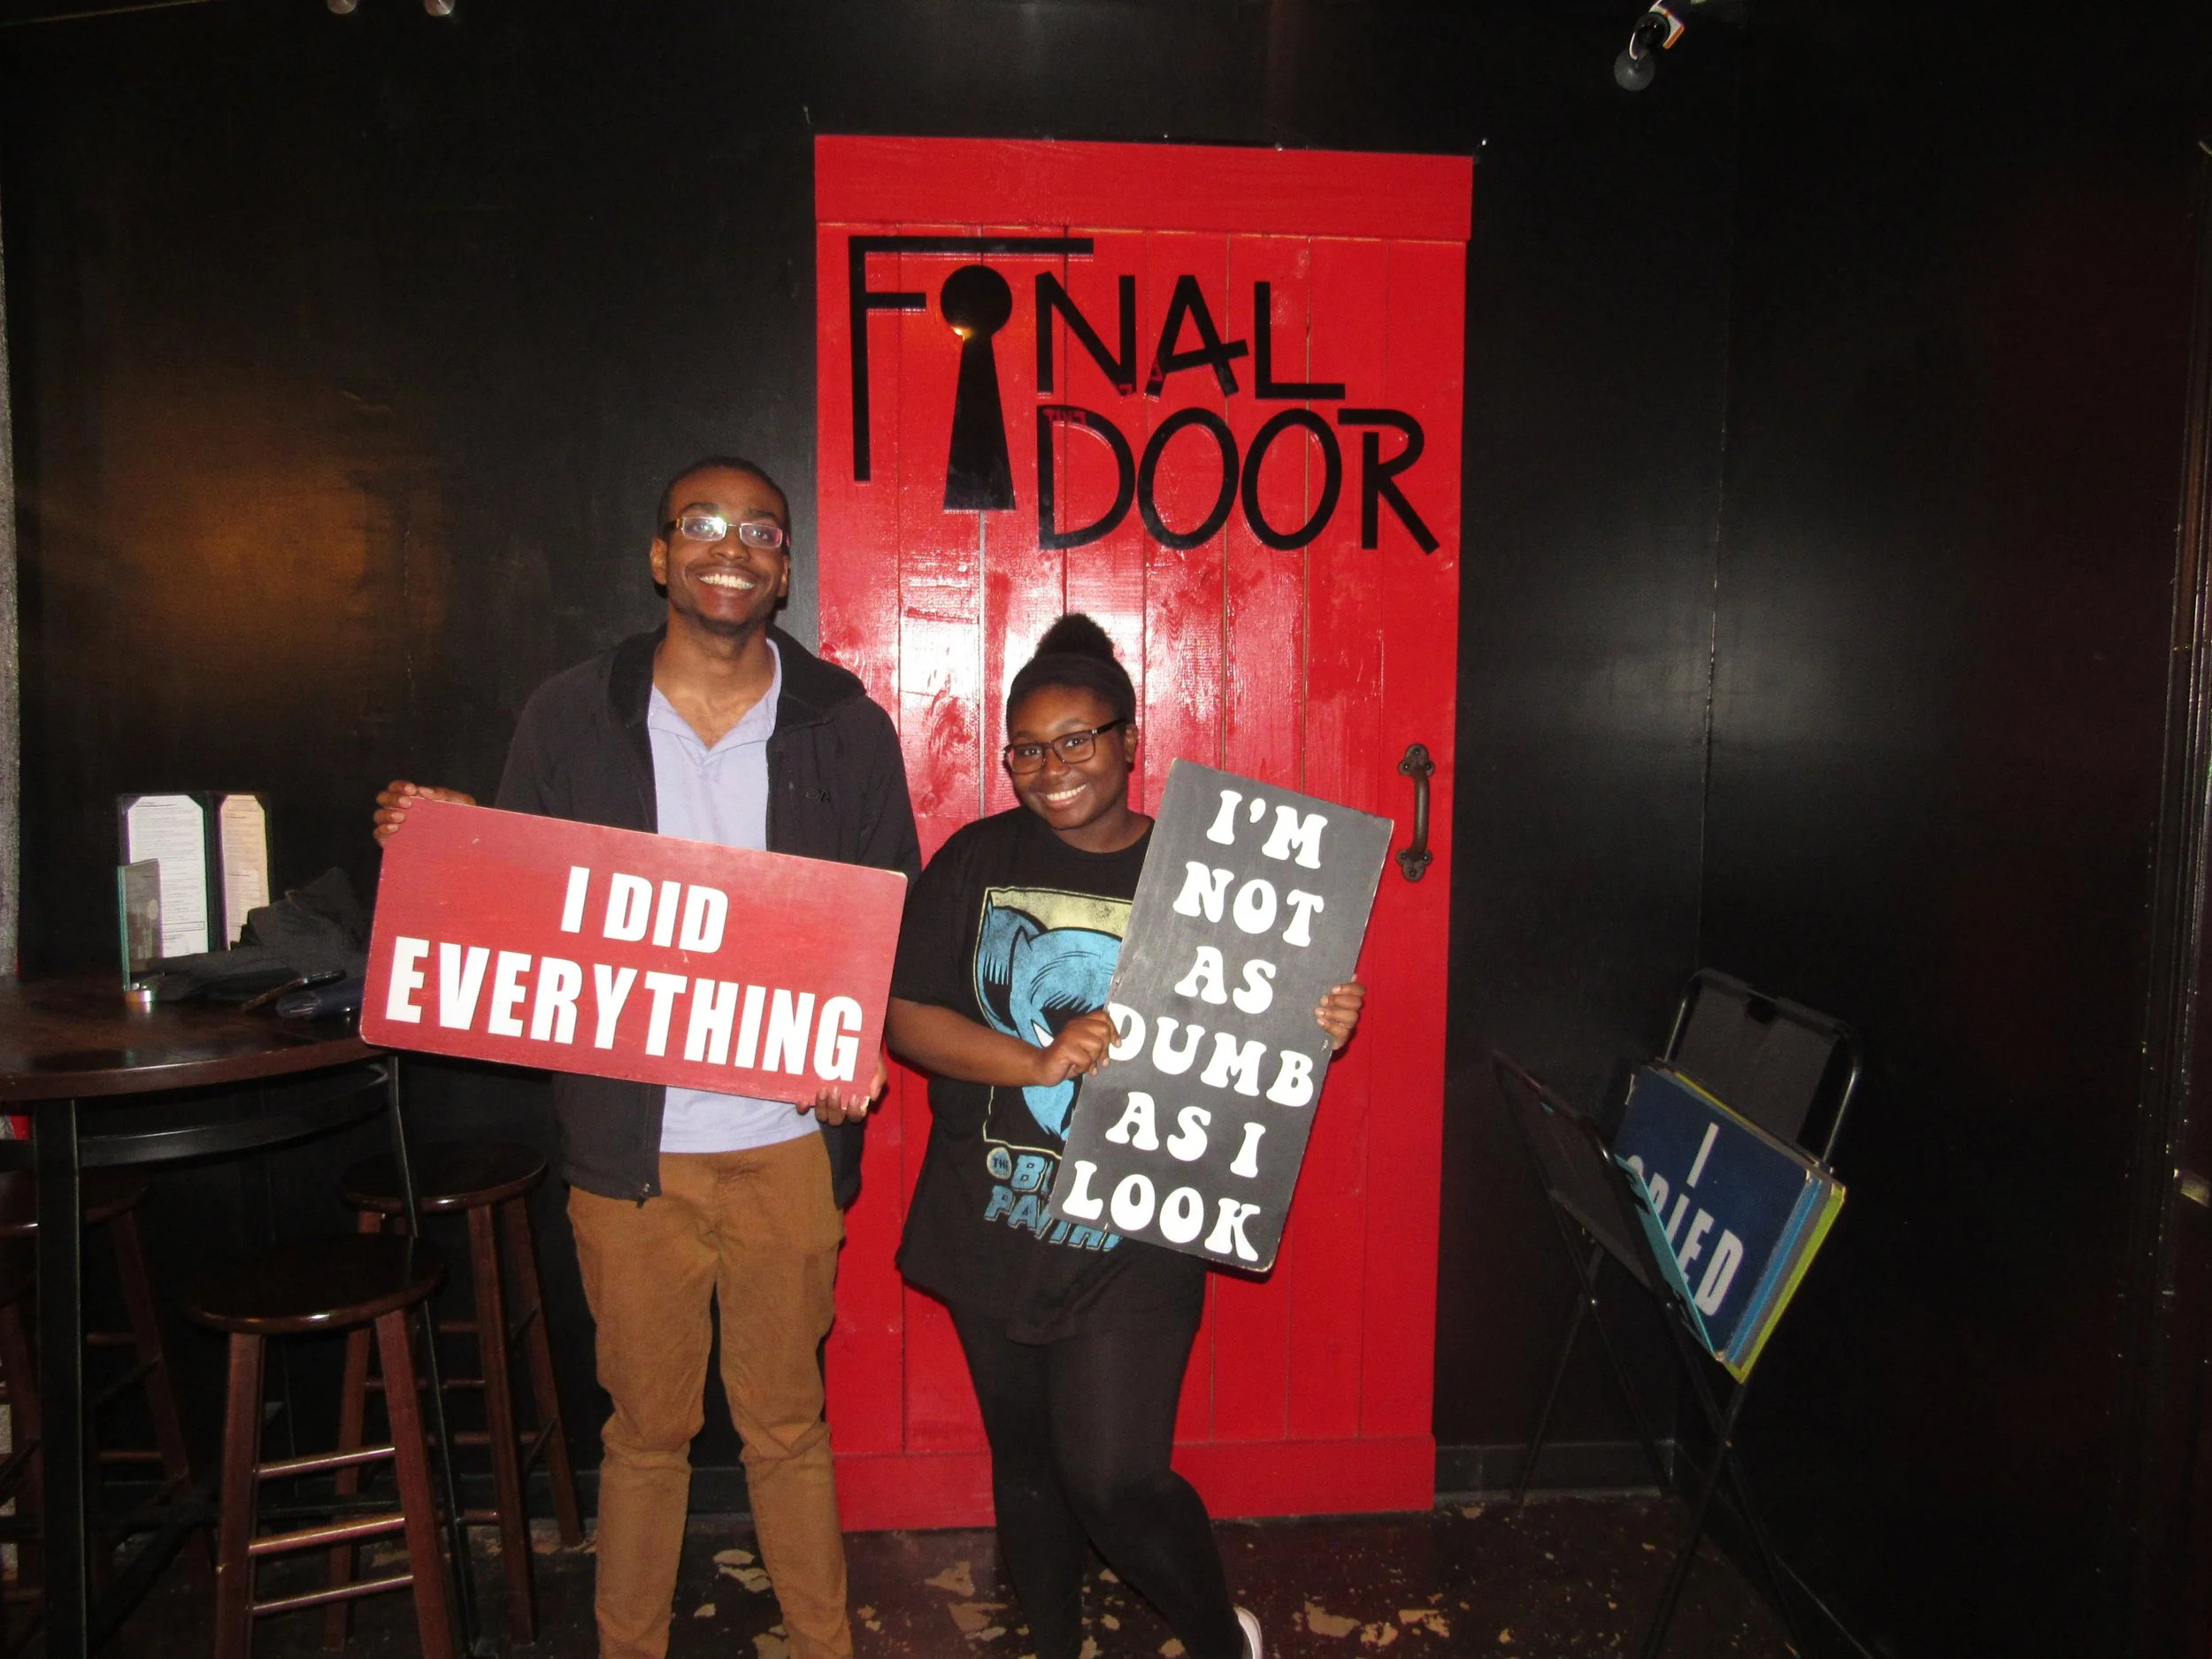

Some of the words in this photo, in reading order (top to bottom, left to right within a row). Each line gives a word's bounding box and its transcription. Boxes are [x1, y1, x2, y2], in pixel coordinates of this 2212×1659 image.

[849, 235, 1345, 511] FINAL
[1037, 404, 1440, 555] DOOR
[1207, 790, 1328, 869] I'M
[561, 866, 590, 933] I
[603, 872, 728, 954] DID
[1172, 861, 1324, 947] NOT
[385, 936, 863, 1082] EVERYTHING
[1174, 946, 1277, 1014] AS
[1108, 1002, 1314, 1107] DUMB
[1105, 1091, 1211, 1162] AS
[1230, 1122, 1266, 1179] I
[1686, 1122, 1719, 1188] I
[1062, 1160, 1261, 1262] LOOK
[1627, 1155, 1744, 1317] IED
